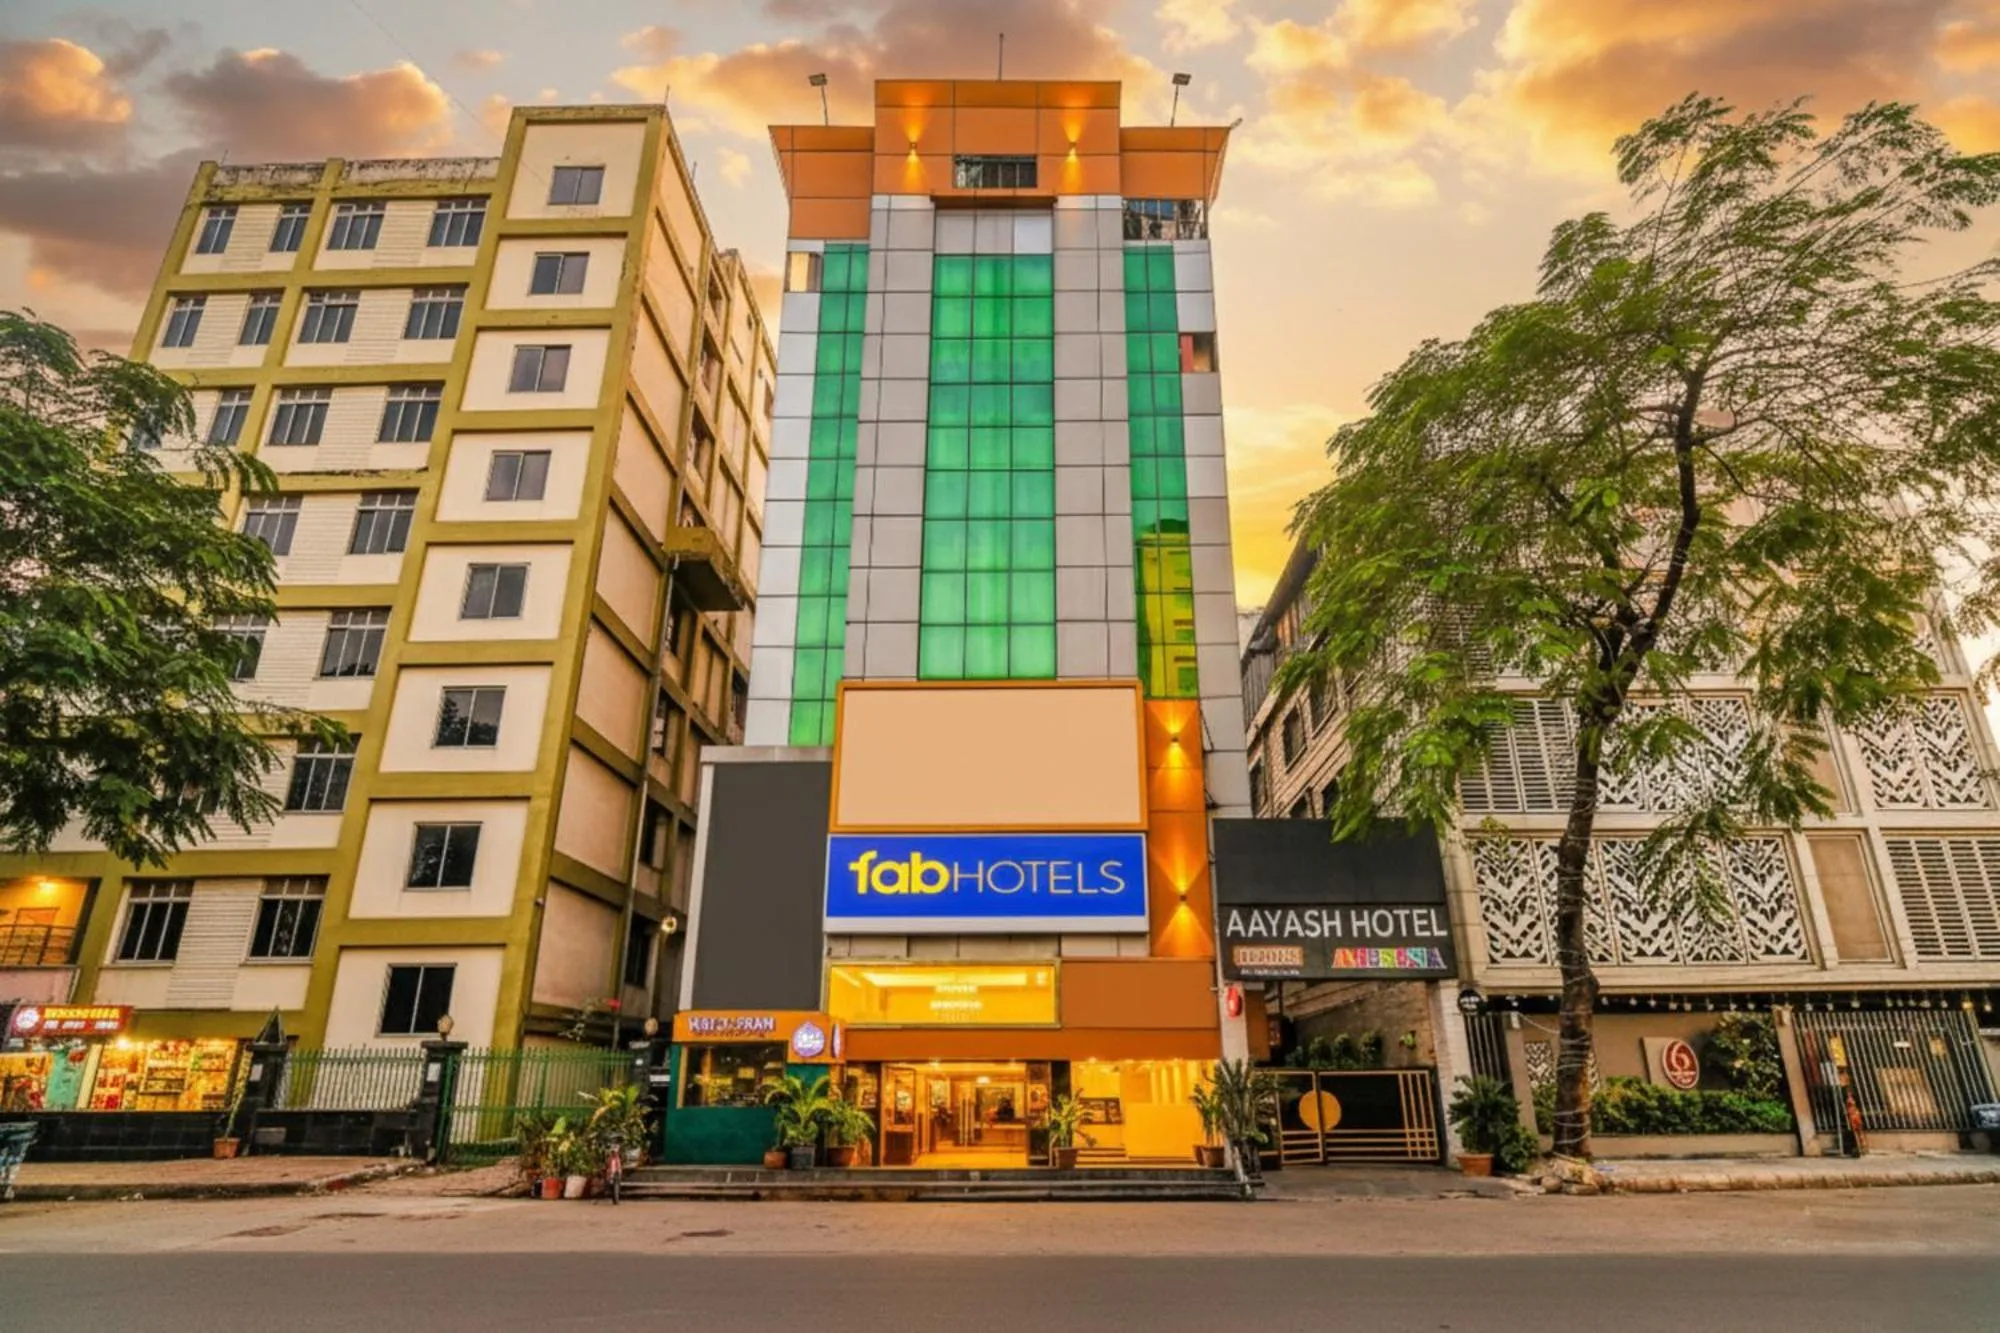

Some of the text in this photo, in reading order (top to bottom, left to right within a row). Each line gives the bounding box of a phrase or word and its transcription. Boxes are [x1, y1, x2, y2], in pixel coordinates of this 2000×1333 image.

[848, 850, 1126, 895] fabHOTELS
[1226, 908, 1448, 938] AAYASH HOTEL
